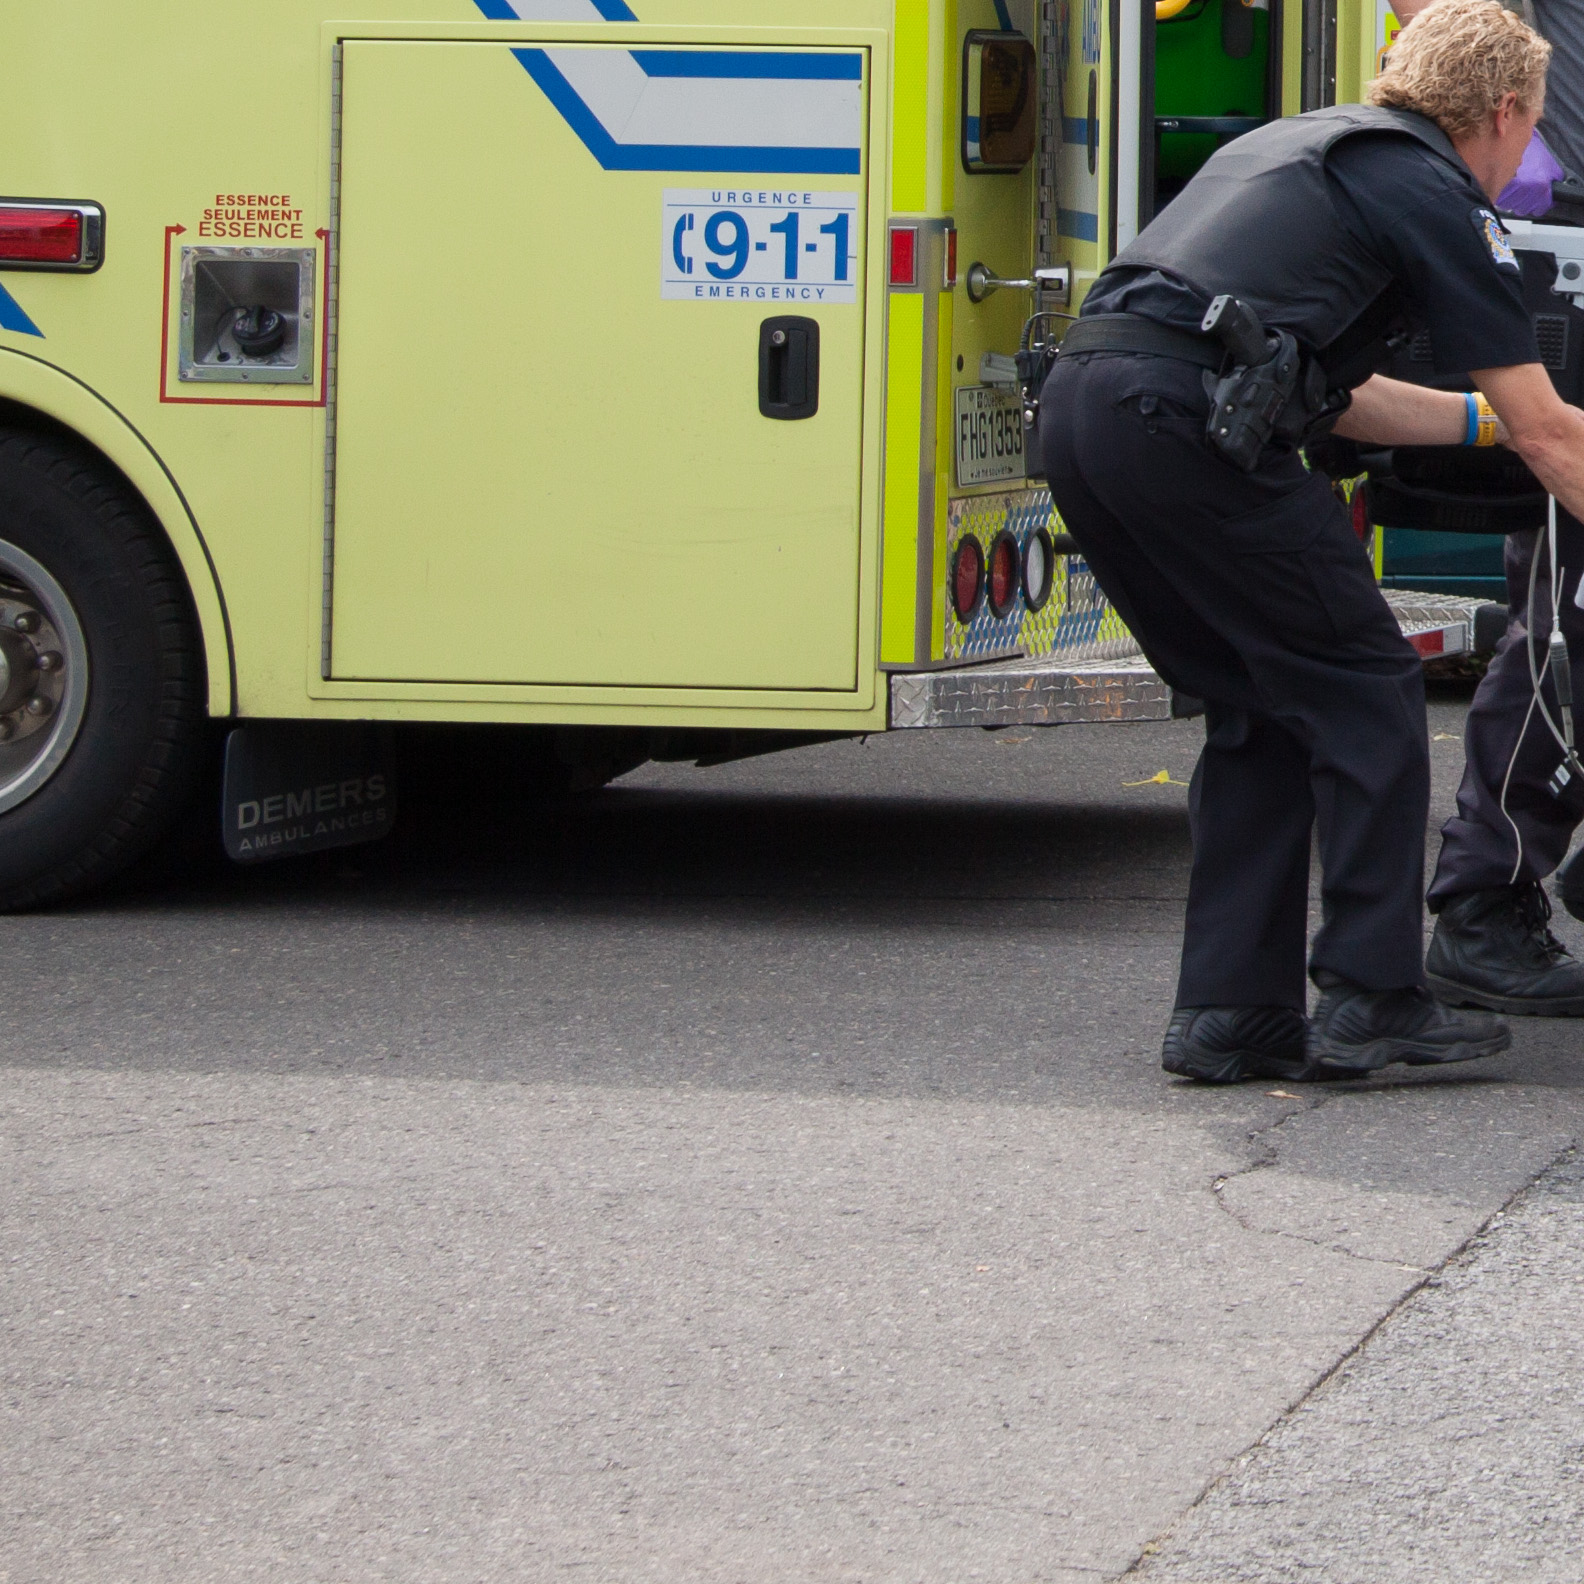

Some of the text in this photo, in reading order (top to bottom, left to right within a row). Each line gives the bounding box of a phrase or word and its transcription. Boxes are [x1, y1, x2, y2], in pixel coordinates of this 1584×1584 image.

[216, 195, 290, 206] ESSENCE
[712, 192, 812, 204] URGENCE
[203, 209, 303, 221] SEULEMENT
[199, 221, 303, 239] ESSENCE
[704, 210, 849, 281] 9-1-1
[695, 286, 825, 299] EMERGENCY
[960, 408, 1022, 462] FHG1353
[237, 775, 386, 830] DEMERS
[238, 807, 387, 852] AMBULANCES
